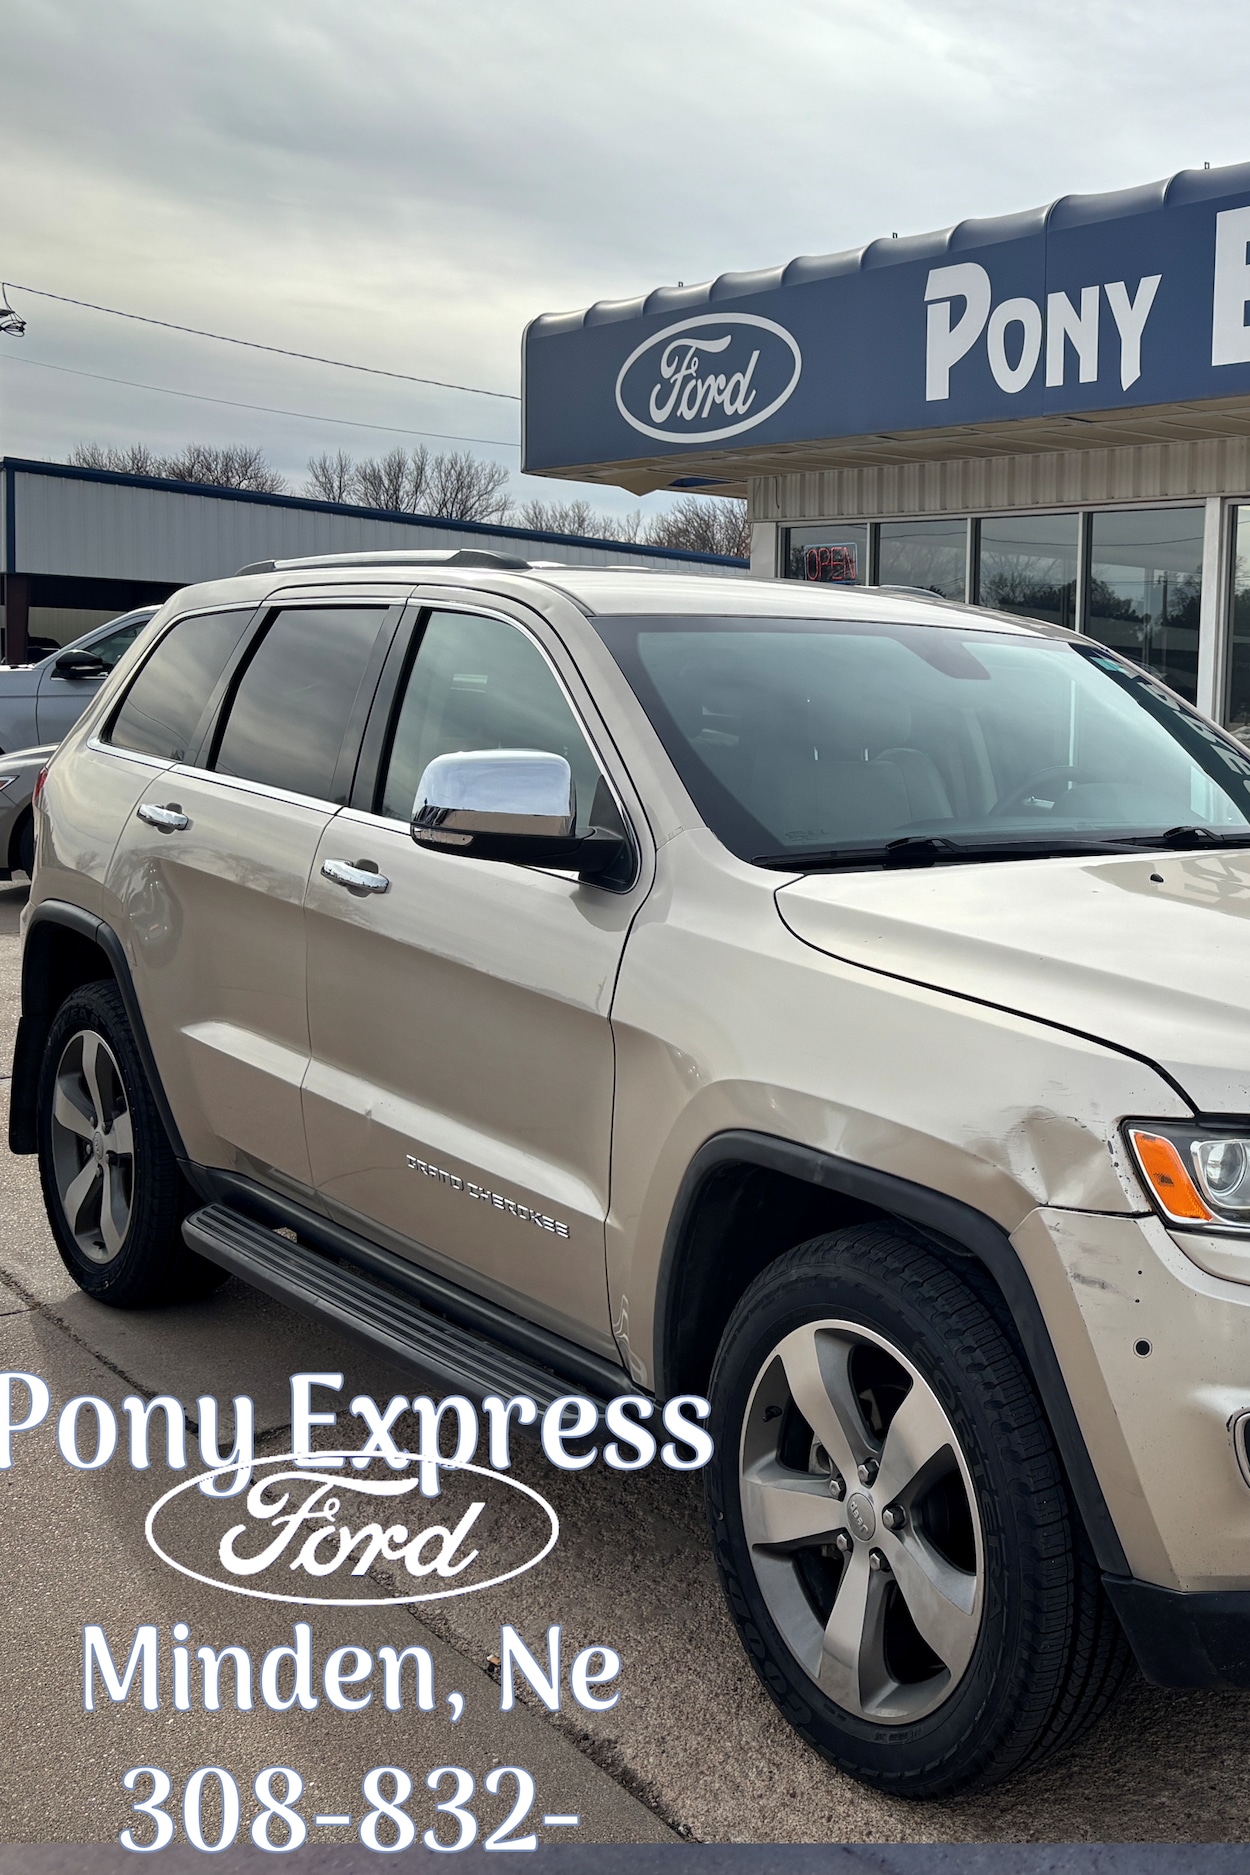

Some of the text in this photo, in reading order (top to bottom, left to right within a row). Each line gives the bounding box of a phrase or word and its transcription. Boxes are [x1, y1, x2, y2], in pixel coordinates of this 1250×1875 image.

[924, 262, 1162, 402] PONY
[649, 334, 760, 424] Ford
[806, 546, 857, 581] OPEN
